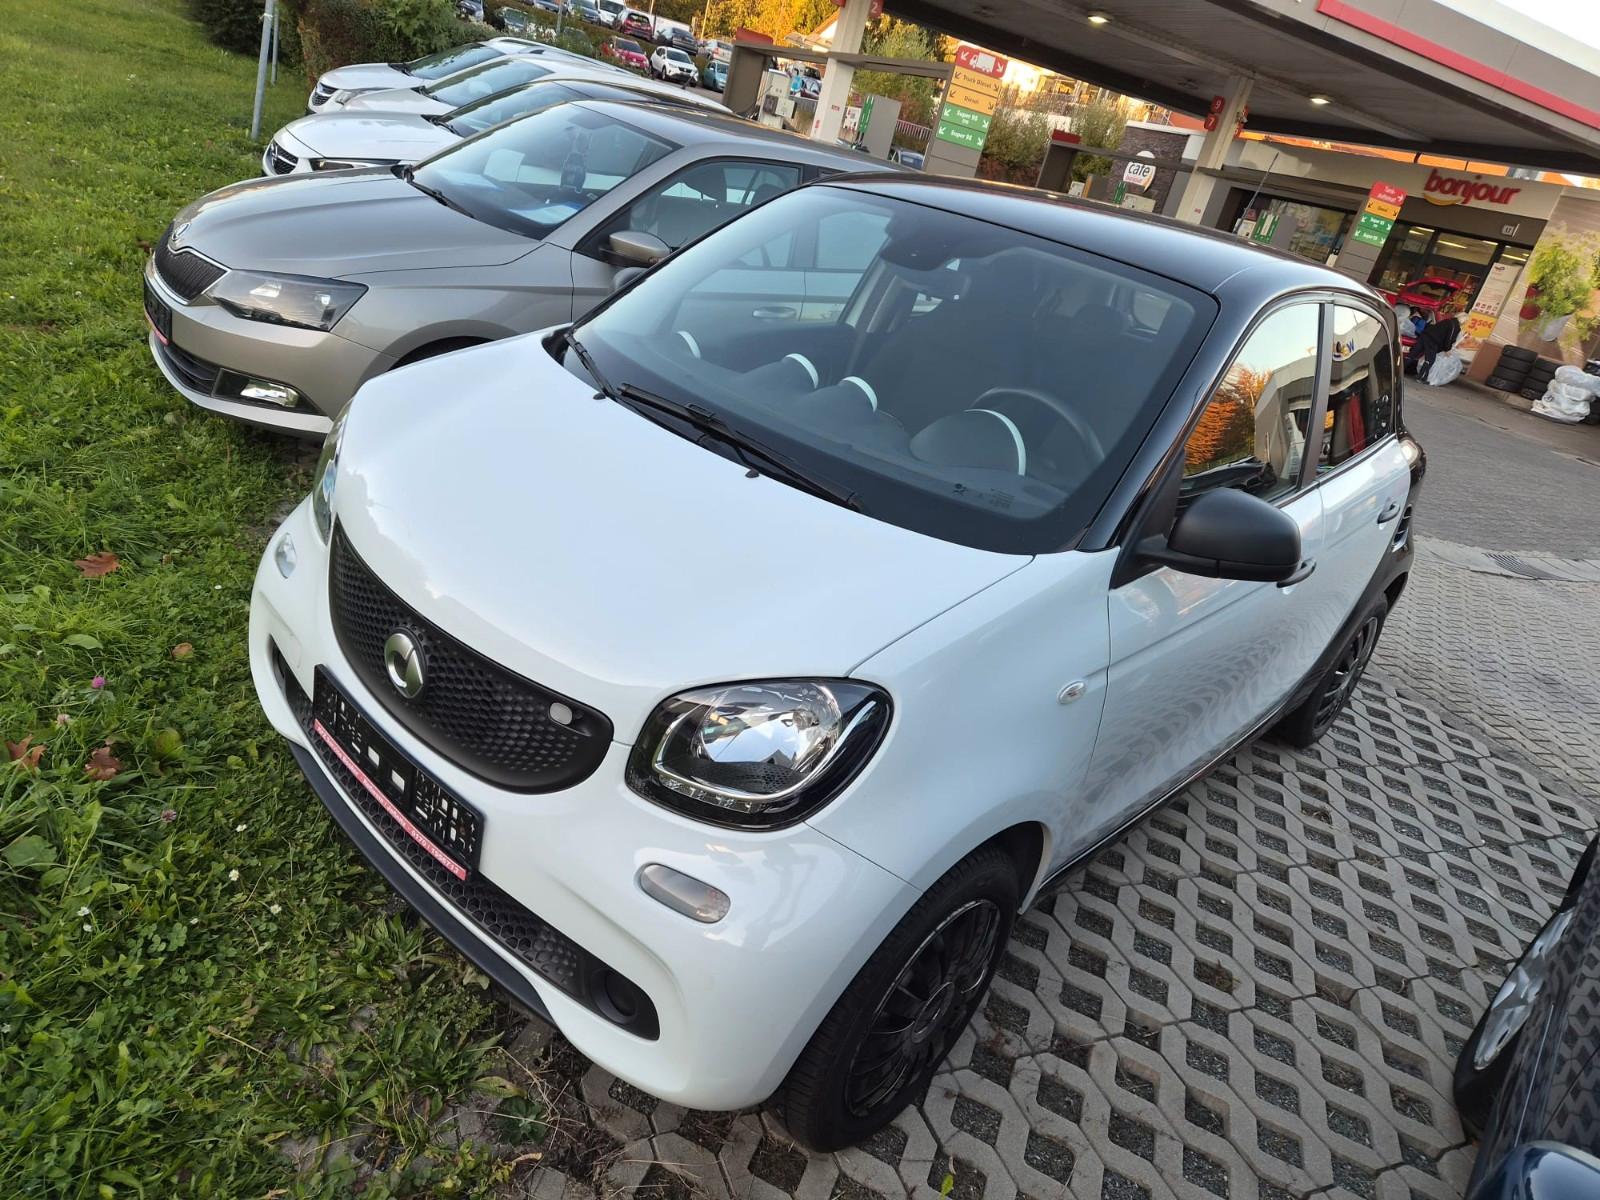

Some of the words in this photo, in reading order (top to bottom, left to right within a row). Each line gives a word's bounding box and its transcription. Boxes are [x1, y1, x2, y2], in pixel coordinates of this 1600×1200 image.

[871, 2, 878, 13] 2
[1207, 117, 1215, 127] 7
[1424, 169, 1521, 205] bonjour
